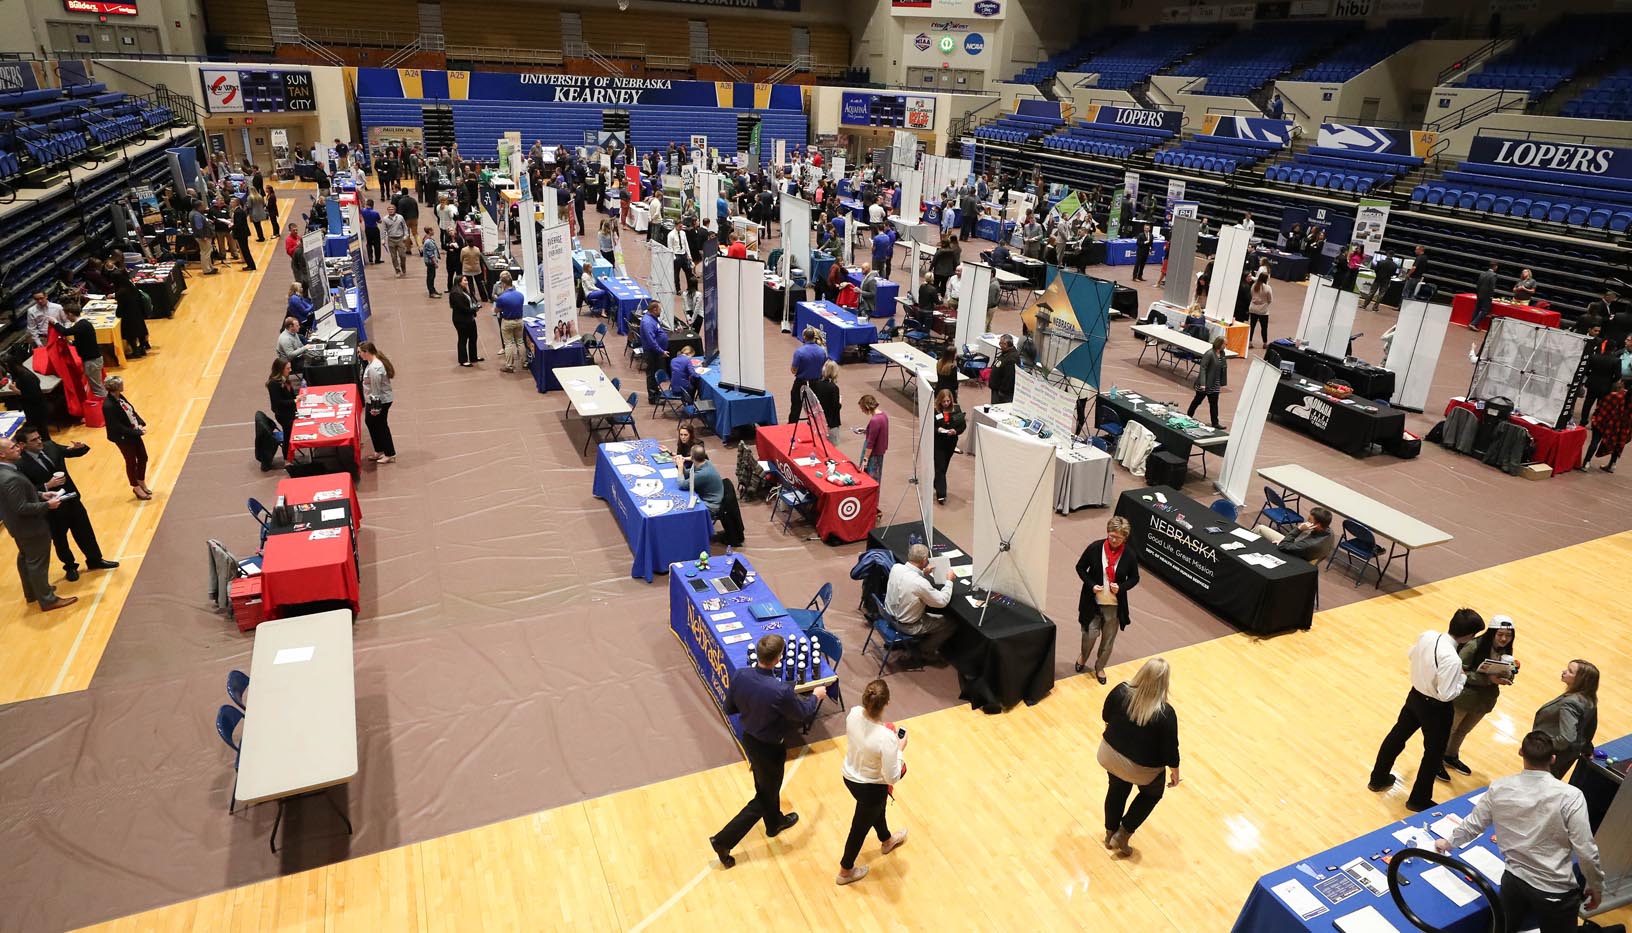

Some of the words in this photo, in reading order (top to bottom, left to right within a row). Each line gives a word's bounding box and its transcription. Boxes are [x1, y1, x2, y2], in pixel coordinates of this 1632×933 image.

[286, 74, 308, 85] SUN
[404, 70, 419, 78] A24
[449, 71, 465, 79] A25
[520, 73, 590, 87] UNIVERSITY
[594, 76, 610, 87] OF
[613, 77, 672, 90] NEBRASKA
[287, 86, 310, 97] TAN
[553, 86, 644, 105] KEARNEY
[289, 99, 312, 110] CITY
[1115, 108, 1164, 128] LOPERS
[1420, 134, 1434, 145] A5
[1494, 141, 1615, 174] LOPERS
[1053, 317, 1075, 332] NEBRASKA
[1312, 398, 1333, 418] OMAHA
[1149, 514, 1217, 563] NEBRASKA
[1147, 532, 1163, 546] Good
[1163, 541, 1175, 554] Life.
[1175, 549, 1192, 564] Great
[1191, 559, 1215, 578] Mission.
[686, 594, 730, 689] Nebraska
